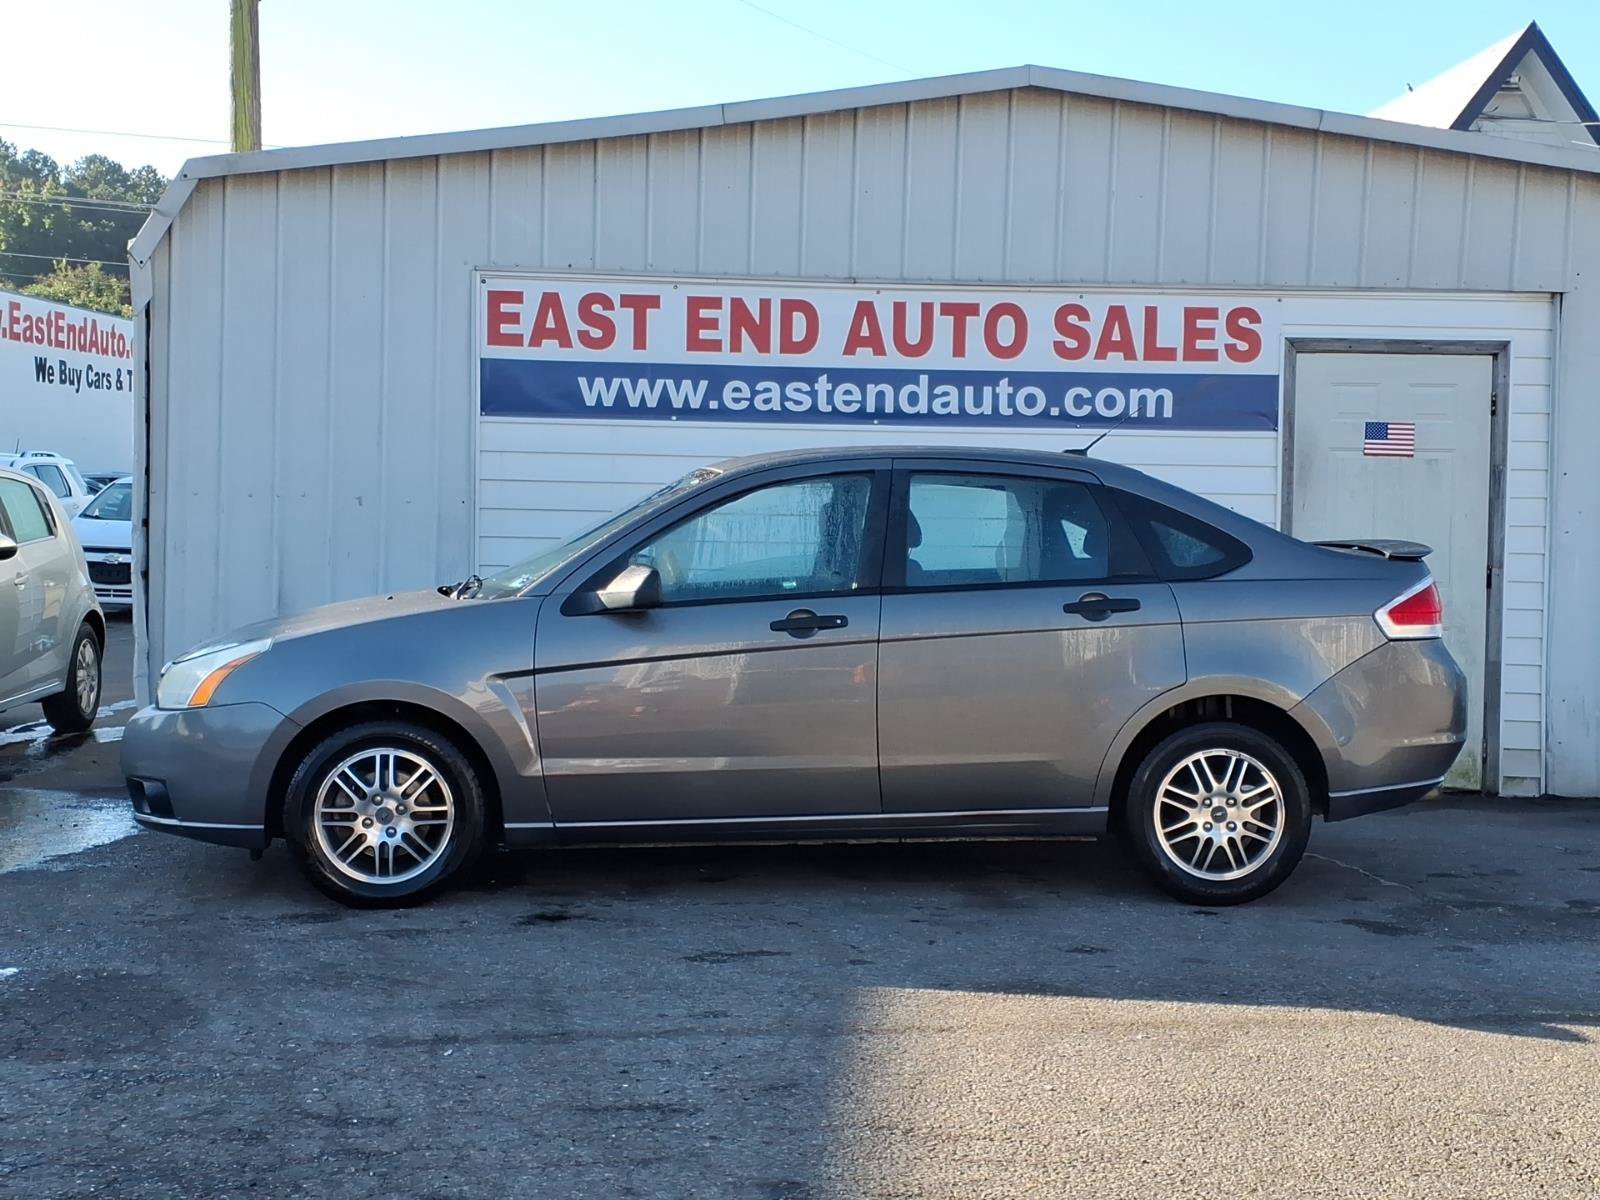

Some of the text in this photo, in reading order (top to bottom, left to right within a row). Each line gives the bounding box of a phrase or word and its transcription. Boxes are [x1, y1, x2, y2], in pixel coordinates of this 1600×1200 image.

[0, 301, 133, 359] .EastEndAuto.
[486, 290, 1262, 363] EAST END AUTO SALES
[34, 356, 55, 384] We
[59, 360, 82, 393] Buy
[86, 364, 112, 390] Cars
[116, 368, 123, 391] &
[577, 373, 1174, 418] www.eastendauto.com
